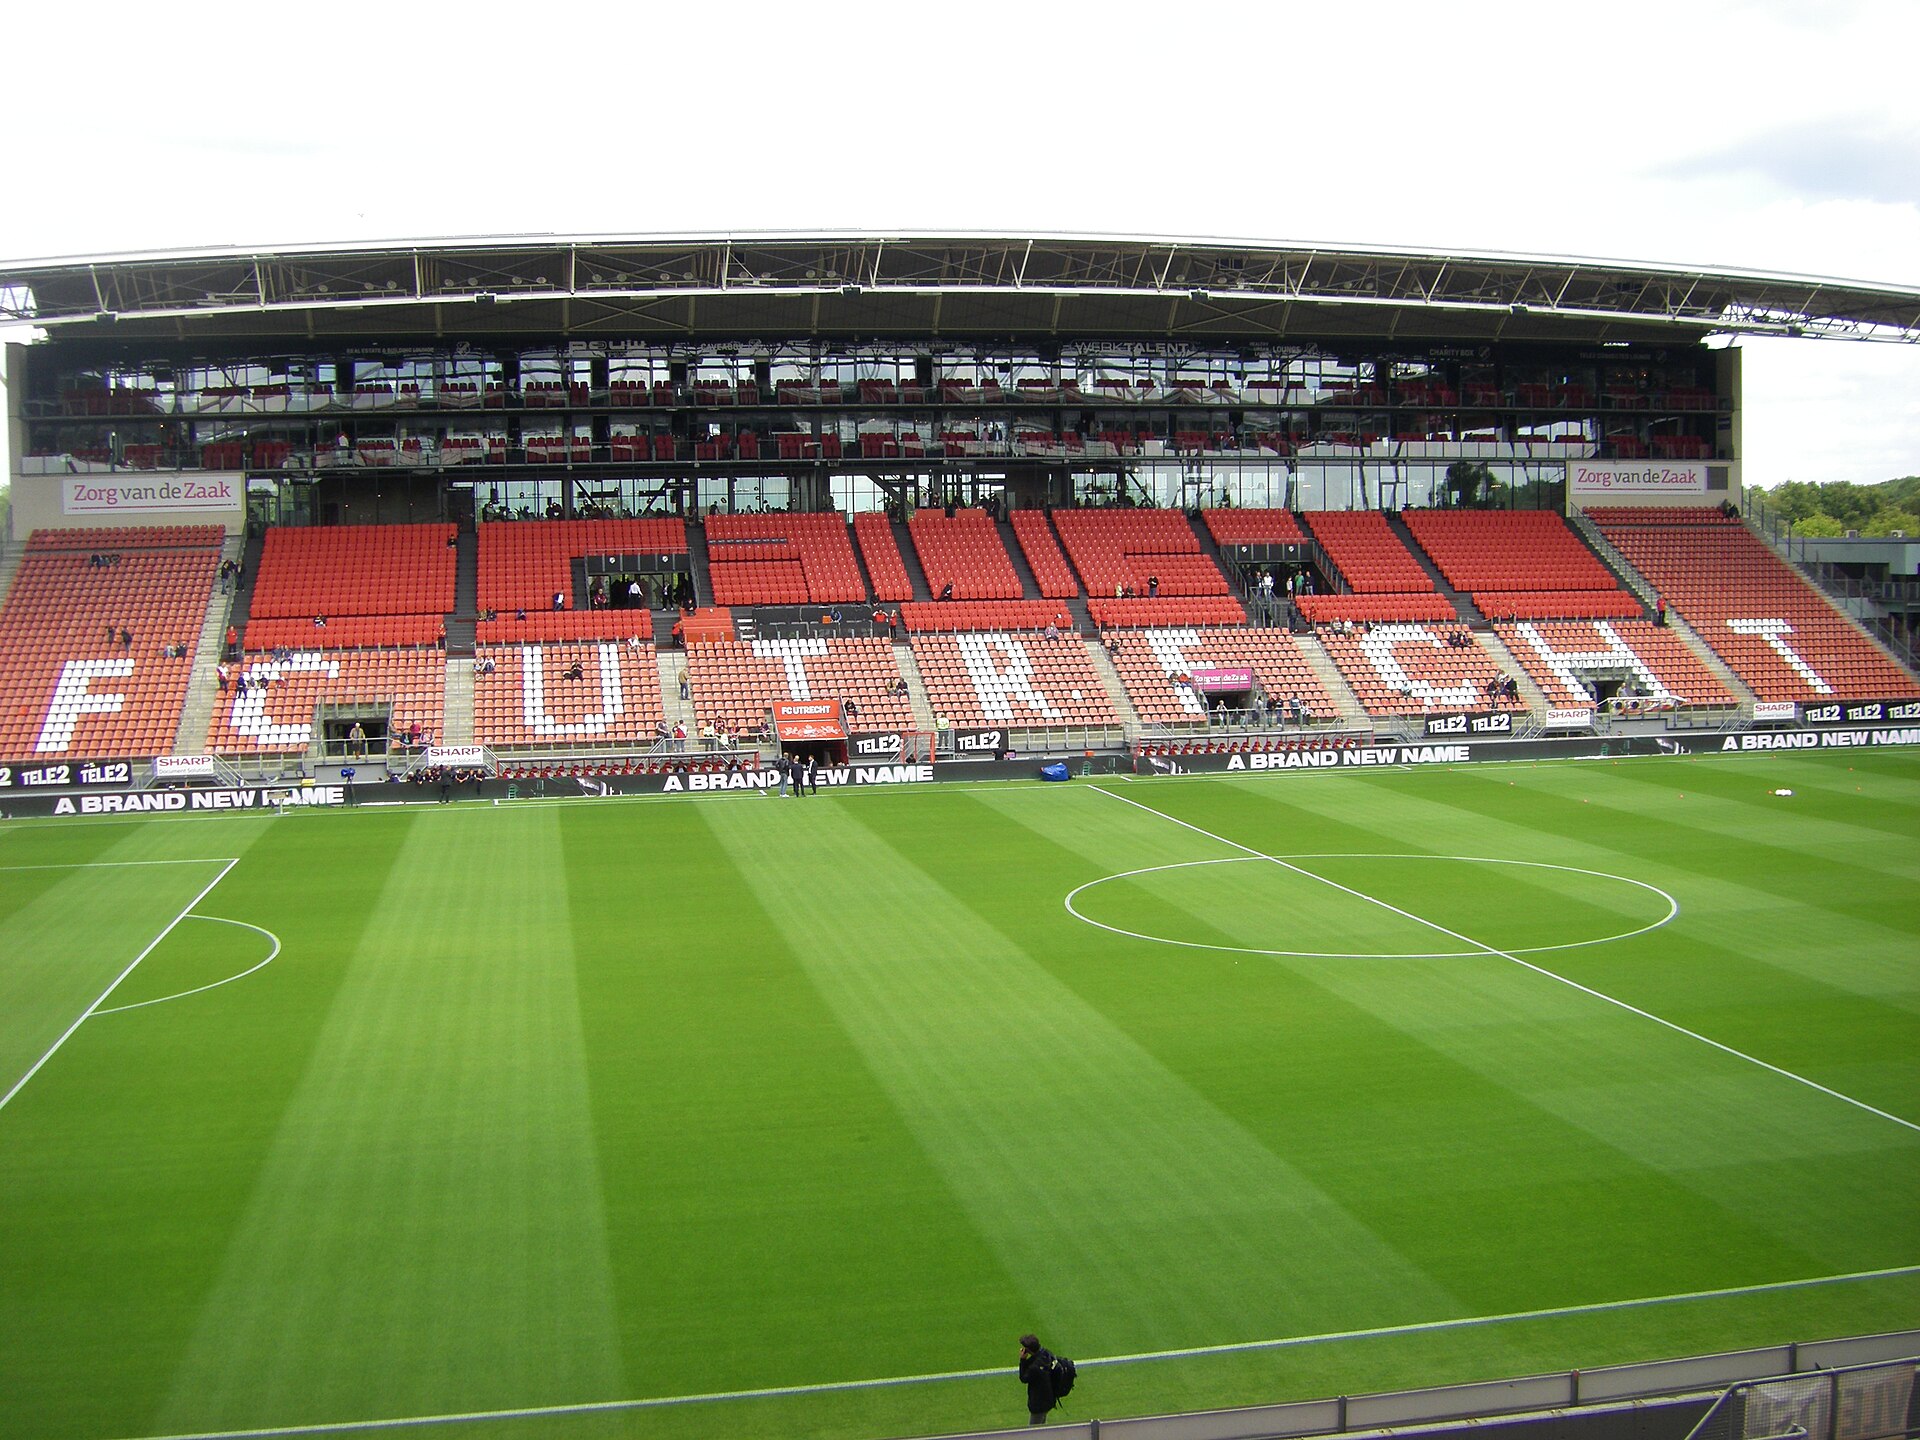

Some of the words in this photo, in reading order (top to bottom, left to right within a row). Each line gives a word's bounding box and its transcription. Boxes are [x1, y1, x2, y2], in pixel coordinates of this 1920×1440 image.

[1074, 341, 1189, 354] WERKTALENT
[1577, 468, 1612, 487] Zorg
[1613, 472, 1640, 484] van
[1642, 469, 1660, 484] de
[1661, 469, 1697, 484] Zaak
[74, 485, 118, 504] Zorg
[120, 486, 155, 500] van
[159, 483, 181, 499] de
[184, 481, 232, 499] Zaak
[781, 706, 792, 715] FC
[793, 706, 831, 715] UTRECHT
[1547, 710, 1589, 719] SHARP
[1754, 704, 1794, 712] SHARP
[1805, 704, 1841, 722] TELE2
[1847, 703, 1882, 720] TELE2
[1428, 715, 1467, 733] TELE2
[1472, 713, 1510, 732] TELE2
[856, 734, 902, 755] TELE2
[957, 730, 1001, 750] TELE2
[1722, 736, 1739, 750] A
[1742, 732, 1818, 750] BRAND
[1822, 731, 1869, 747] NEW
[1872, 729, 1920, 745] NAM
[159, 757, 212, 767] SHARP
[430, 747, 481, 757] SHARP
[1226, 754, 1246, 770] A
[1250, 750, 1339, 770] BRAND
[1343, 748, 1397, 766] NEW
[1401, 746, 1470, 762] NAME
[21, 764, 70, 786] TELE2
[80, 762, 128, 783] TELE2
[663, 774, 684, 792] A
[856, 766, 934, 784] NAME
[54, 797, 76, 815] A
[81, 792, 186, 814] BRAND
[192, 790, 256, 809] NEW
